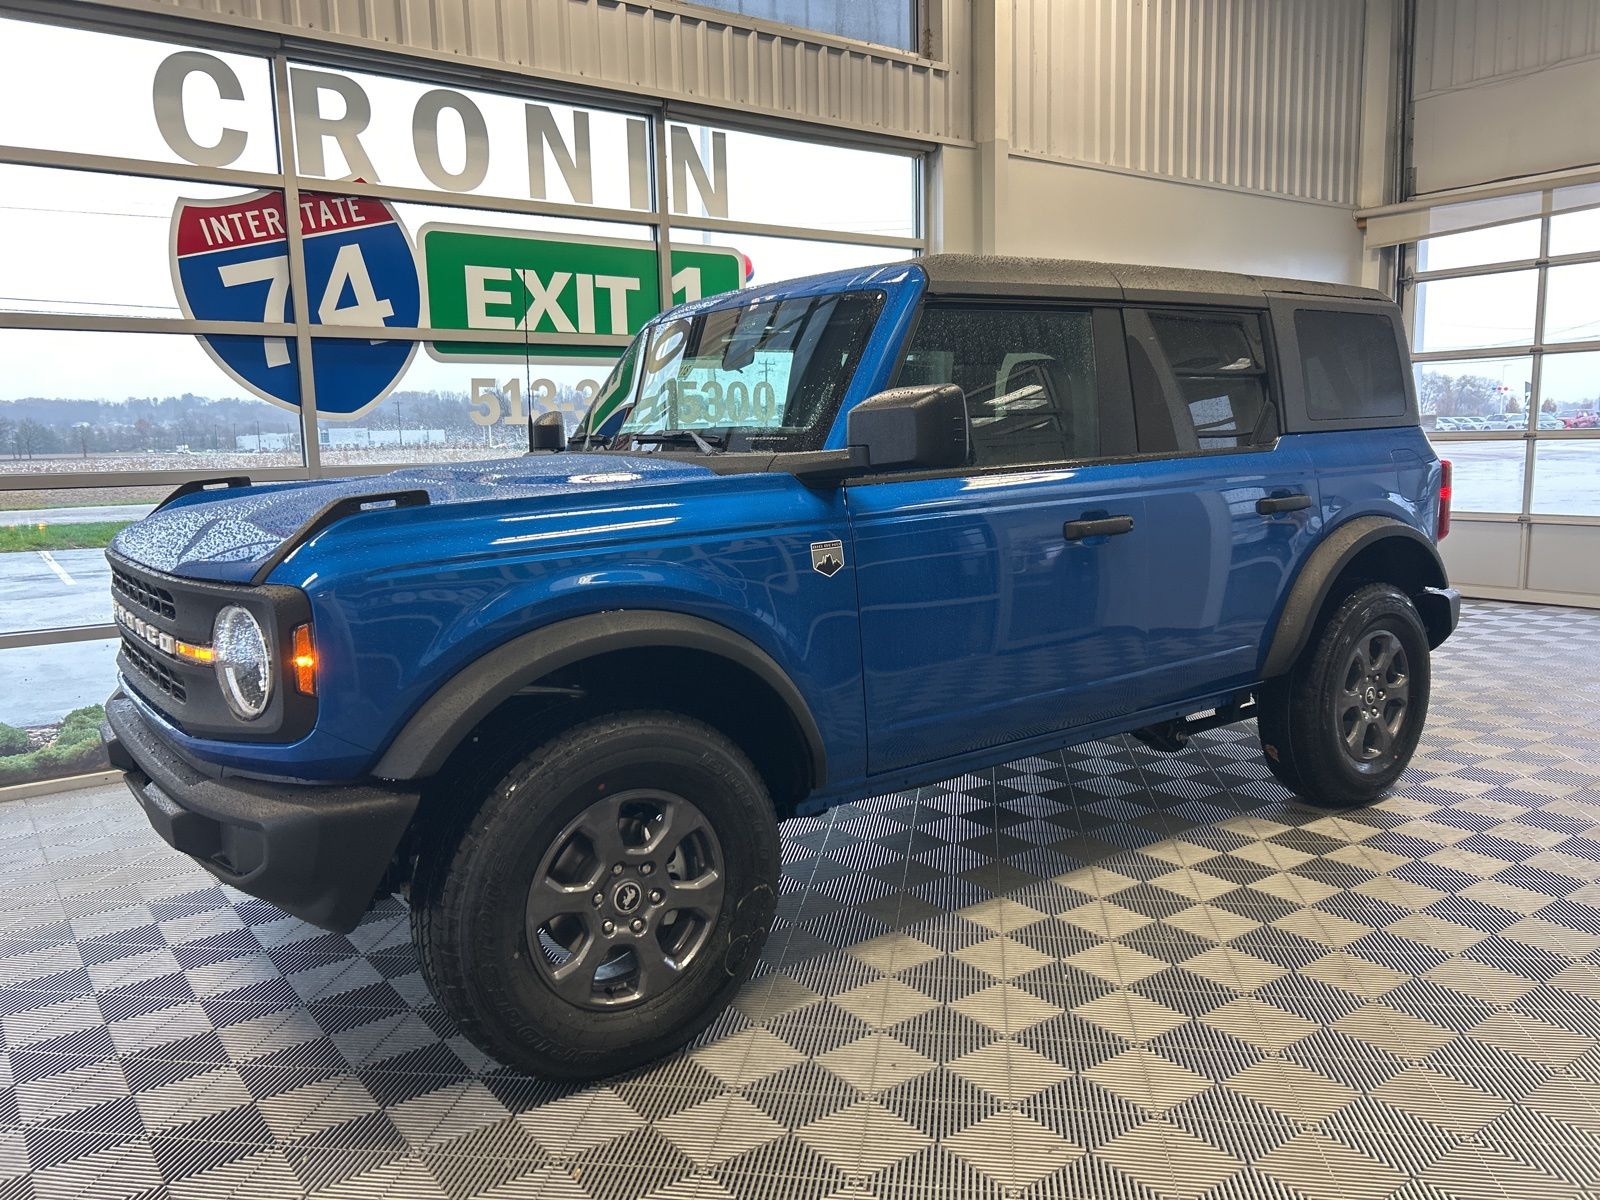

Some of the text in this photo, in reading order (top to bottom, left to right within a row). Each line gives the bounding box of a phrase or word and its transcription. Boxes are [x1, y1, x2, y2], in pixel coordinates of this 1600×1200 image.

[153, 51, 729, 218] CRONIN
[200, 196, 366, 246] INTERTATE
[217, 243, 395, 369] 74
[464, 264, 641, 336] EXIT
